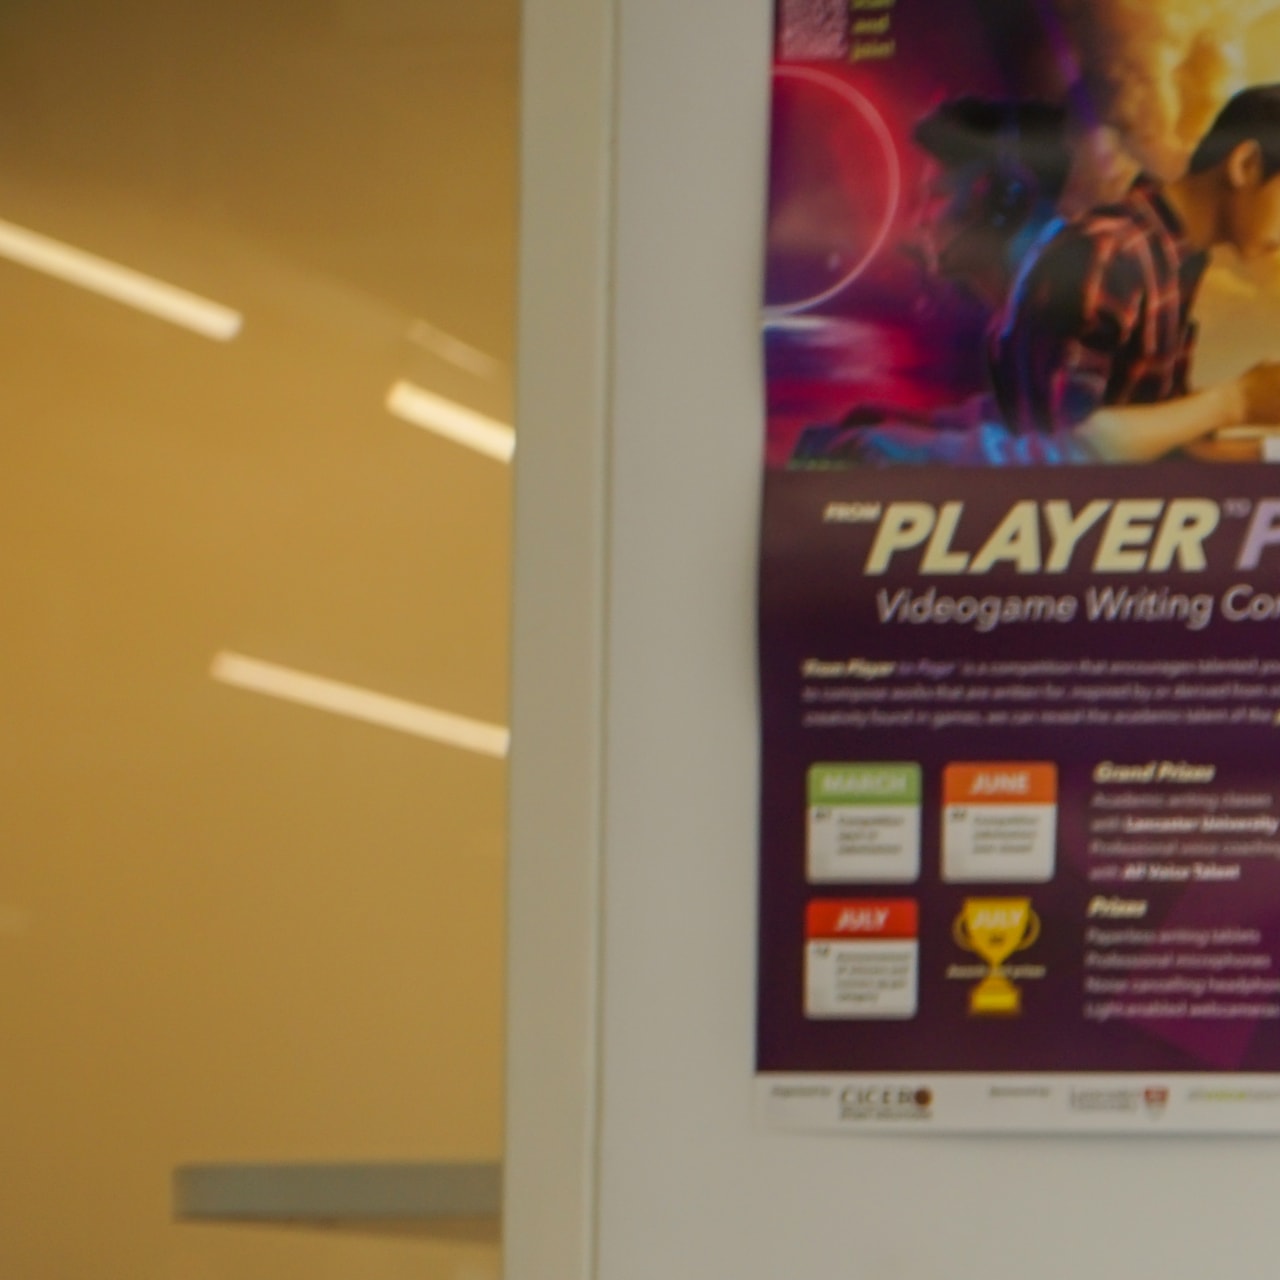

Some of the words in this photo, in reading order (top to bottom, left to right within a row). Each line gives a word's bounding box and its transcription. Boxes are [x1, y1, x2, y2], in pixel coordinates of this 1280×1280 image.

[823, 502, 881, 522] FROM
[864, 497, 1221, 576] PLAYER
[875, 584, 1077, 634] Videogame
[1086, 583, 1214, 631] Writing
[821, 773, 908, 794] MARCH
[970, 772, 1031, 796] JUNE
[1092, 760, 1157, 784] Grand
[1156, 760, 1217, 784] Prizes
[834, 905, 891, 931] JULY
[971, 906, 1026, 930] JULY
[1086, 894, 1149, 919] Prizes
